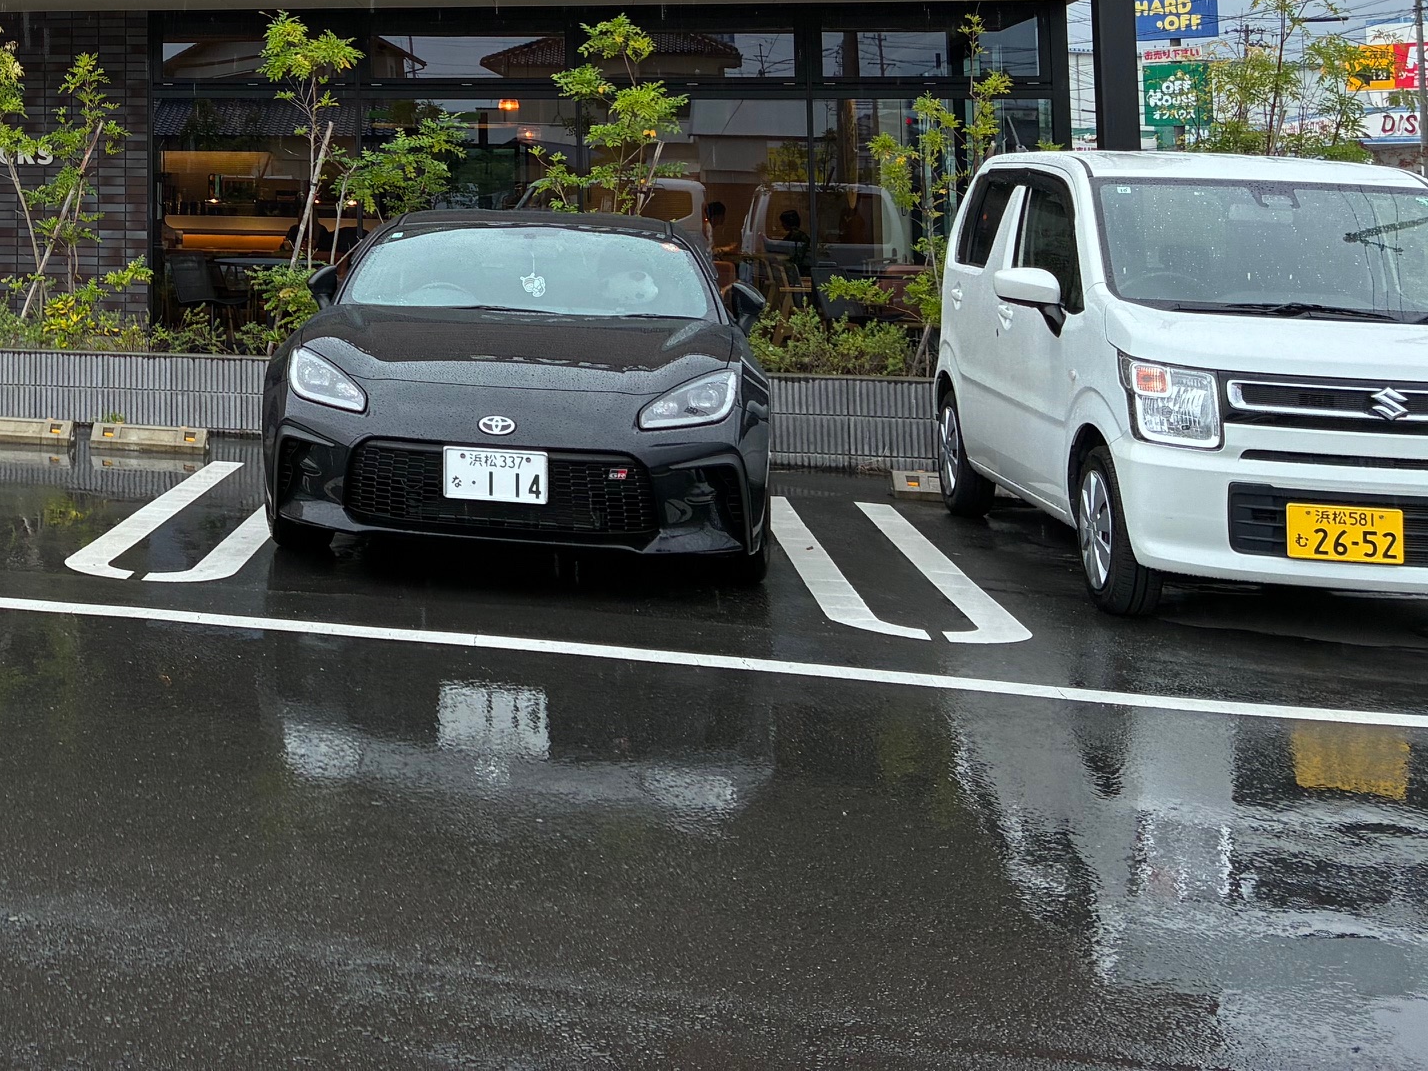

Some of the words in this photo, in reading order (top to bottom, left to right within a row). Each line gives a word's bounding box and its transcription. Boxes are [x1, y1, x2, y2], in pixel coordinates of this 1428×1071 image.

[1164, 14, 1202, 31] OFF
[1144, 48, 1200, 61] お売り下さい
[1381, 114, 1420, 135] DIS
[1314, 528, 1398, 560] 26-52
